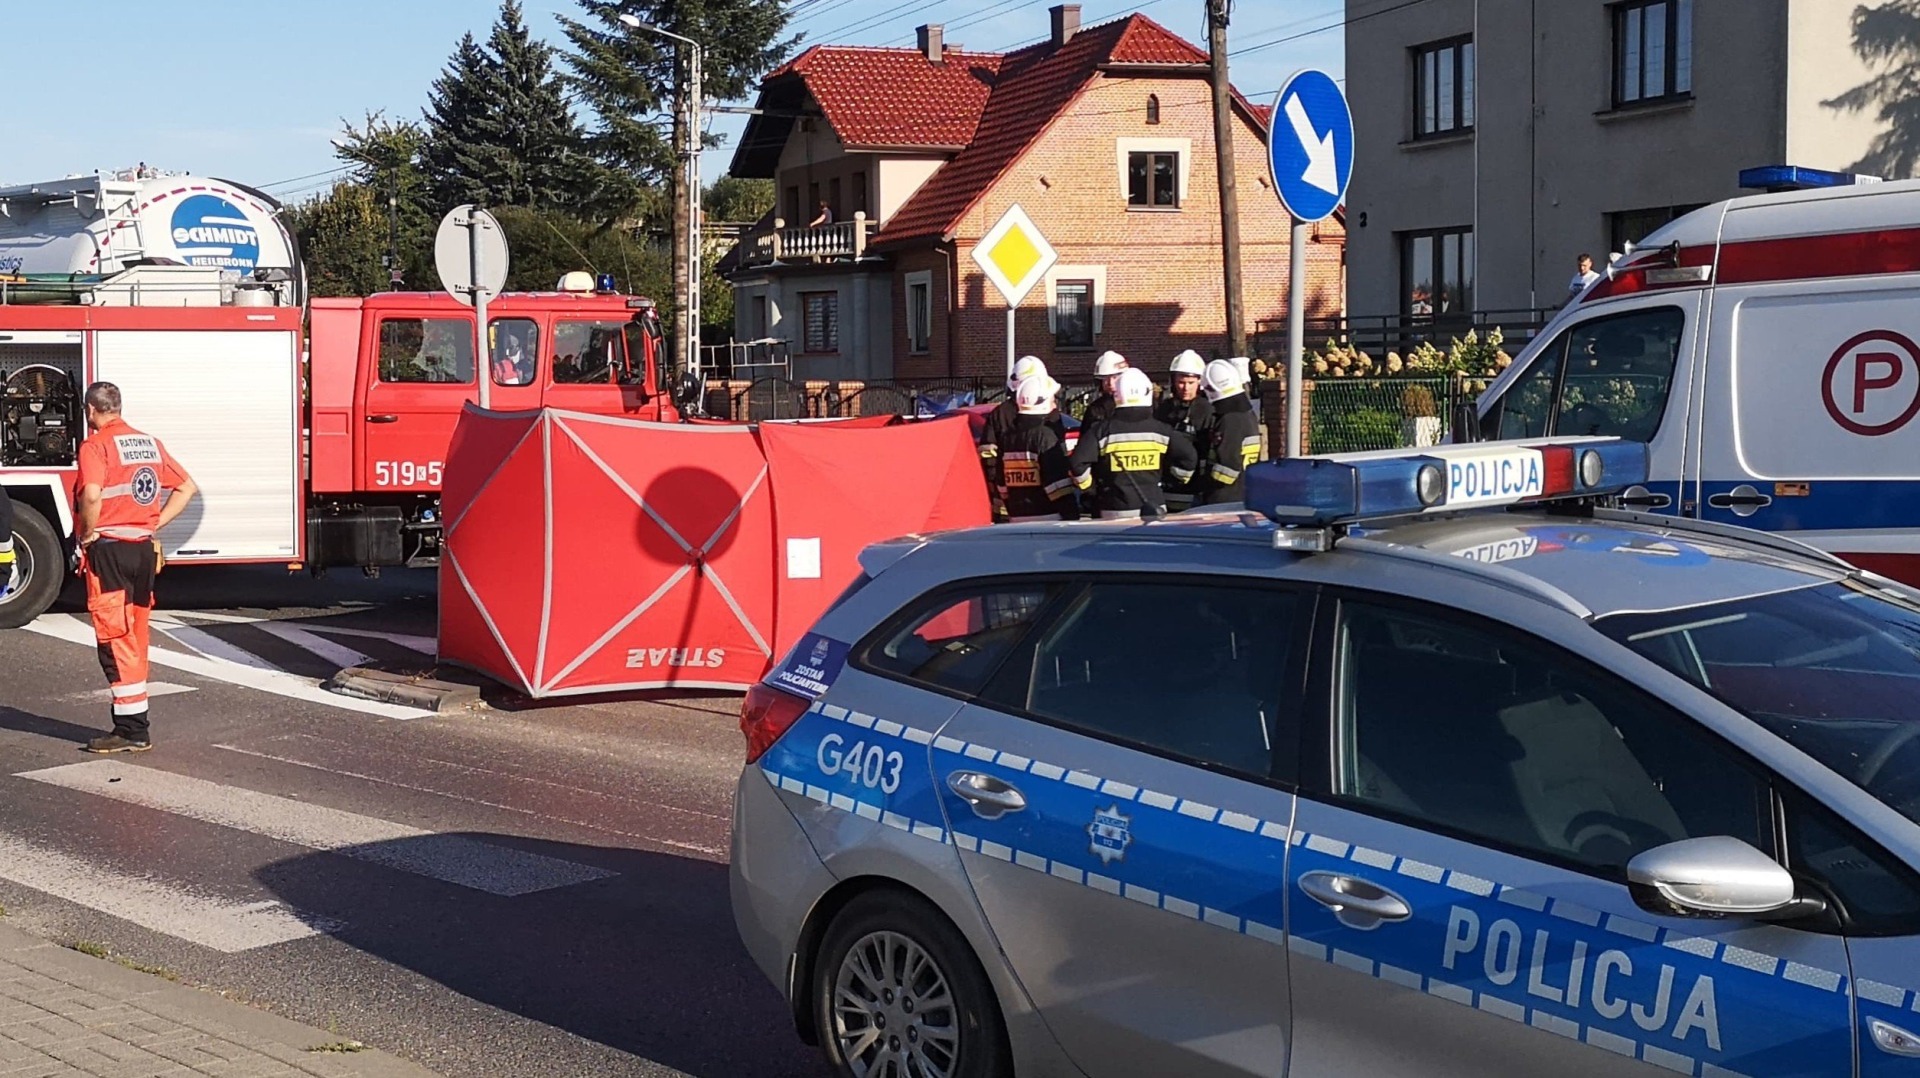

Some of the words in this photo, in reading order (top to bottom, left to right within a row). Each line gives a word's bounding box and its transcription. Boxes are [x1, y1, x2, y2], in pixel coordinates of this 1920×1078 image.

[1360, 211, 1367, 228] 2
[173, 227, 257, 246] SCHMIDT
[192, 257, 253, 267] HEILBRONN
[1853, 352, 1903, 413] P
[119, 438, 153, 447] RATOWNIK
[123, 450, 157, 460] MEDYCZNY
[1450, 457, 1539, 499] POLICJA
[817, 733, 903, 794] G403
[1443, 905, 1722, 1050] POLICJA
